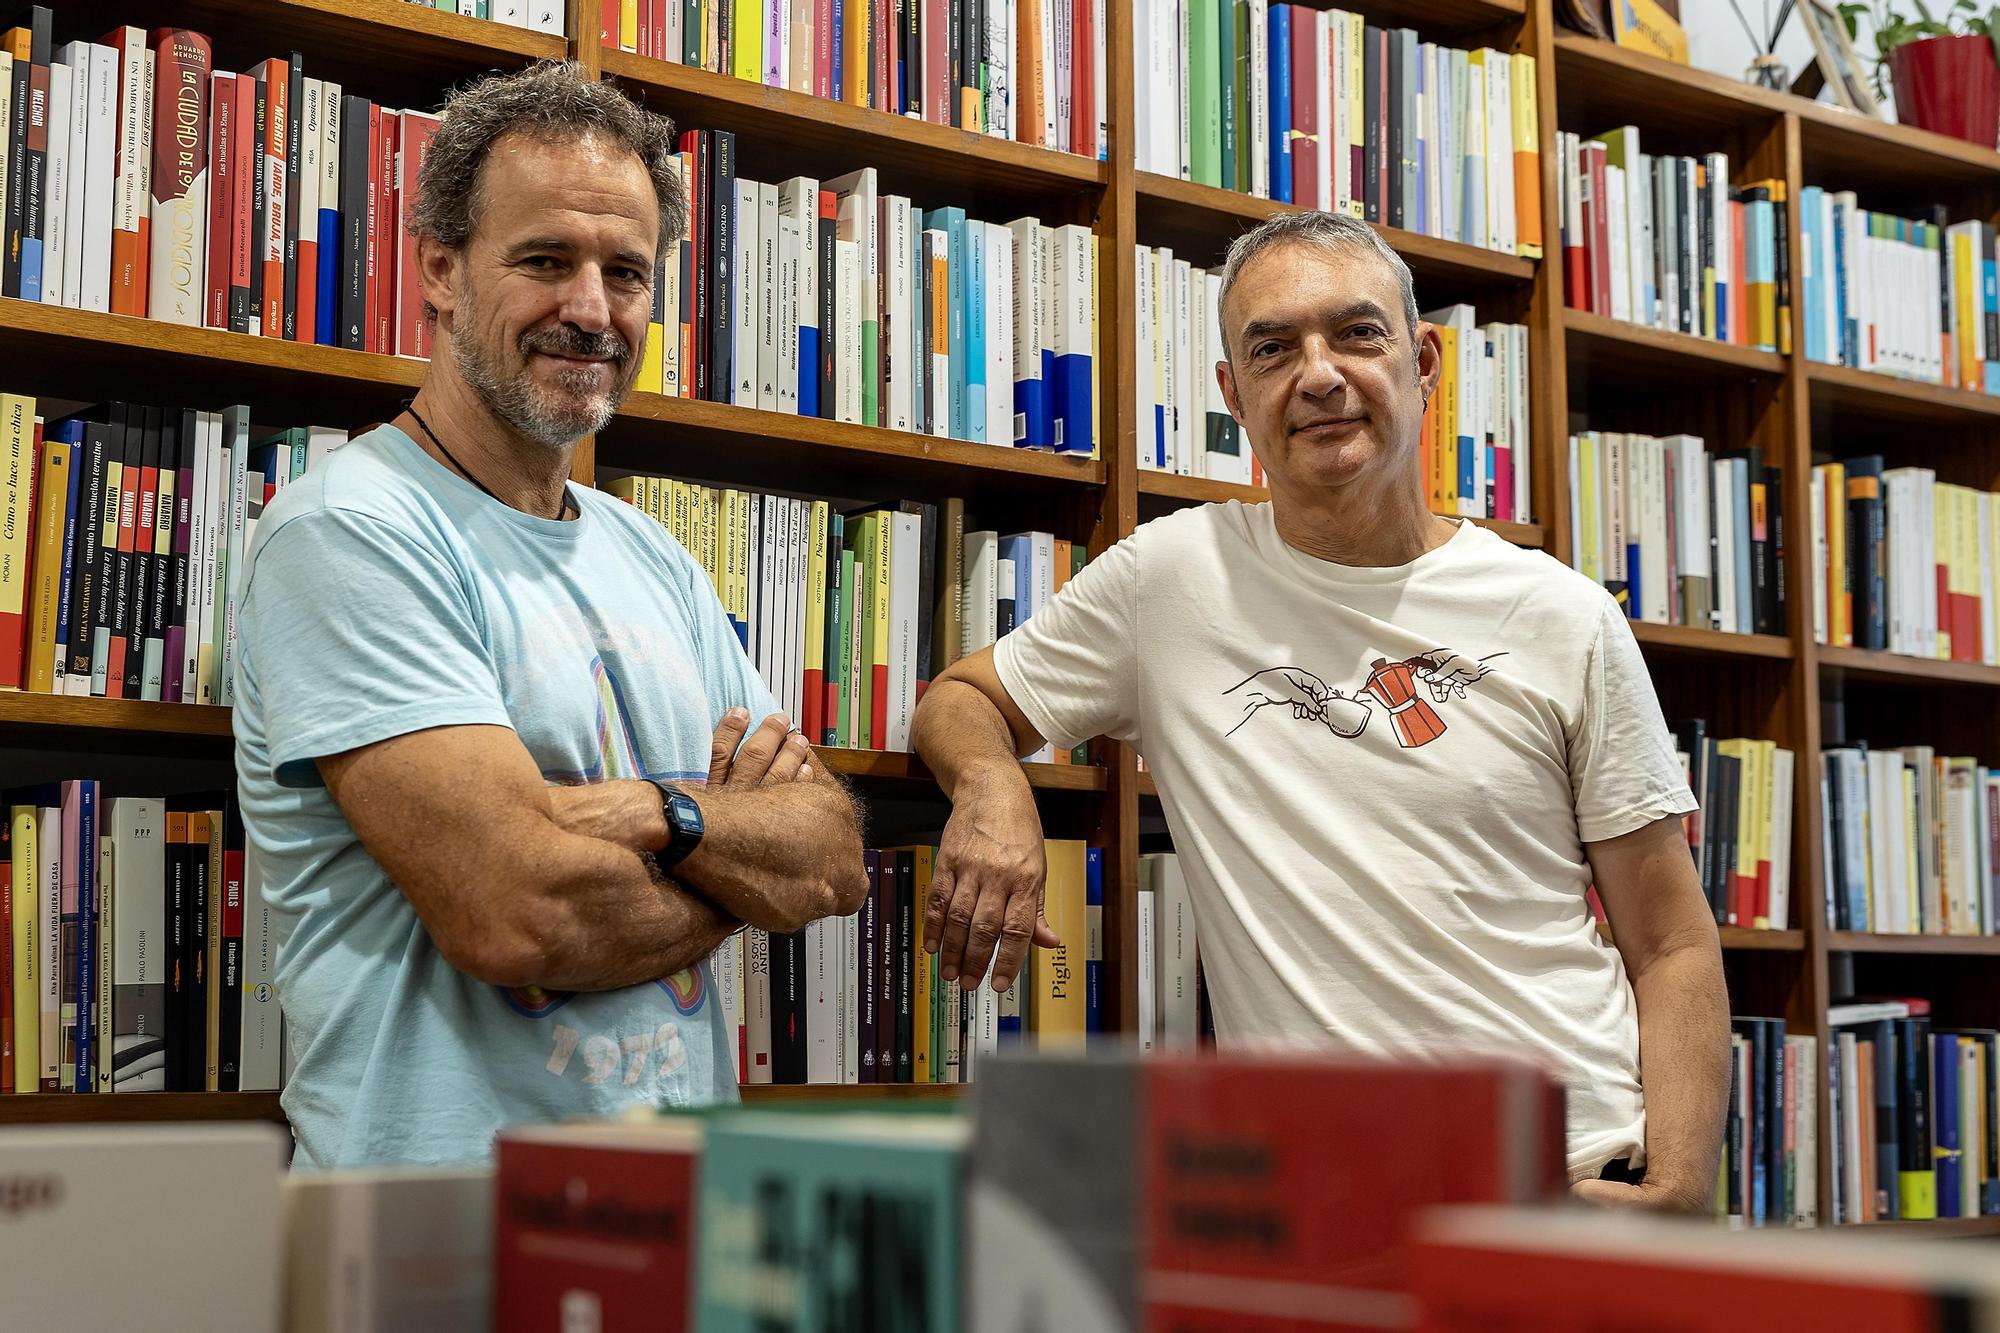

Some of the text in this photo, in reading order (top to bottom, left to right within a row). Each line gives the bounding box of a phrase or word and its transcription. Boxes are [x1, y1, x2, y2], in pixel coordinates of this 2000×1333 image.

[172, 50, 206, 62] MENDOZA
[174, 44, 206, 56] EDUARDO
[1035, 60, 1045, 117] CARCOMA
[31, 89, 44, 127] MELCHOR
[127, 61, 138, 165] UN TAMBOR DIFERENTE
[142, 92, 151, 129] girasoles
[220, 102, 228, 127] Enayat
[308, 89, 317, 132] Oposición
[327, 92, 338, 144] La familia
[274, 104, 284, 155] MERRITT
[218, 137, 227, 162] huellas
[720, 138, 729, 178] ALFAGUARA
[170, 70, 199, 296] LA CIUDAD DE LOS PRODIGIOS
[255, 181, 263, 210] SUSANA
[806, 188, 815, 208] sirga
[124, 173, 134, 230] William Melvin
[806, 210, 813, 220] de
[270, 202, 282, 242] BRUJA,
[1032, 226, 1040, 248] Jesús
[1032, 250, 1039, 259] de
[1076, 235, 1085, 282] Lectura fácil
[1030, 326, 1039, 357] Últimas
[4, 403, 22, 540] Cómo se hace una chica
[85, 440, 102, 564] cuando la revolución termine
[106, 486, 118, 524] NAVARRO
[122, 491, 134, 528] NAVARRO
[141, 491, 154, 528] NAVARRO
[160, 494, 172, 530] NAVARRO
[180, 498, 188, 523] NAVARRO
[235, 488, 243, 504] JOSÉ
[234, 506, 242, 530] MARÍA
[728, 528, 735, 536] de
[740, 530, 746, 539] de
[802, 508, 810, 544] Psicopomp
[816, 506, 824, 558] Psicopompo
[880, 516, 888, 567] vulnerables
[2, 554, 10, 583] MORAN
[118, 570, 126, 589] voces
[120, 556, 128, 570] Las
[158, 558, 166, 568] La
[158, 570, 166, 582] isla
[98, 552, 112, 623] La isla de los conejos
[156, 592, 164, 602] los
[176, 558, 186, 606] La trabajadora
[61, 578, 70, 626] GERALD MURNANE
[80, 574, 92, 642] LEILA NACHAWATI
[115, 599, 124, 630] Adriana
[154, 604, 162, 630] conejos
[52, 881, 58, 891] DE
[228, 880, 238, 907] PAULS
[51, 932, 58, 942] LA
[227, 962, 235, 986] Borges
[1052, 945, 1070, 1001] Piglia
[546, 1022, 686, 1086] 1972
